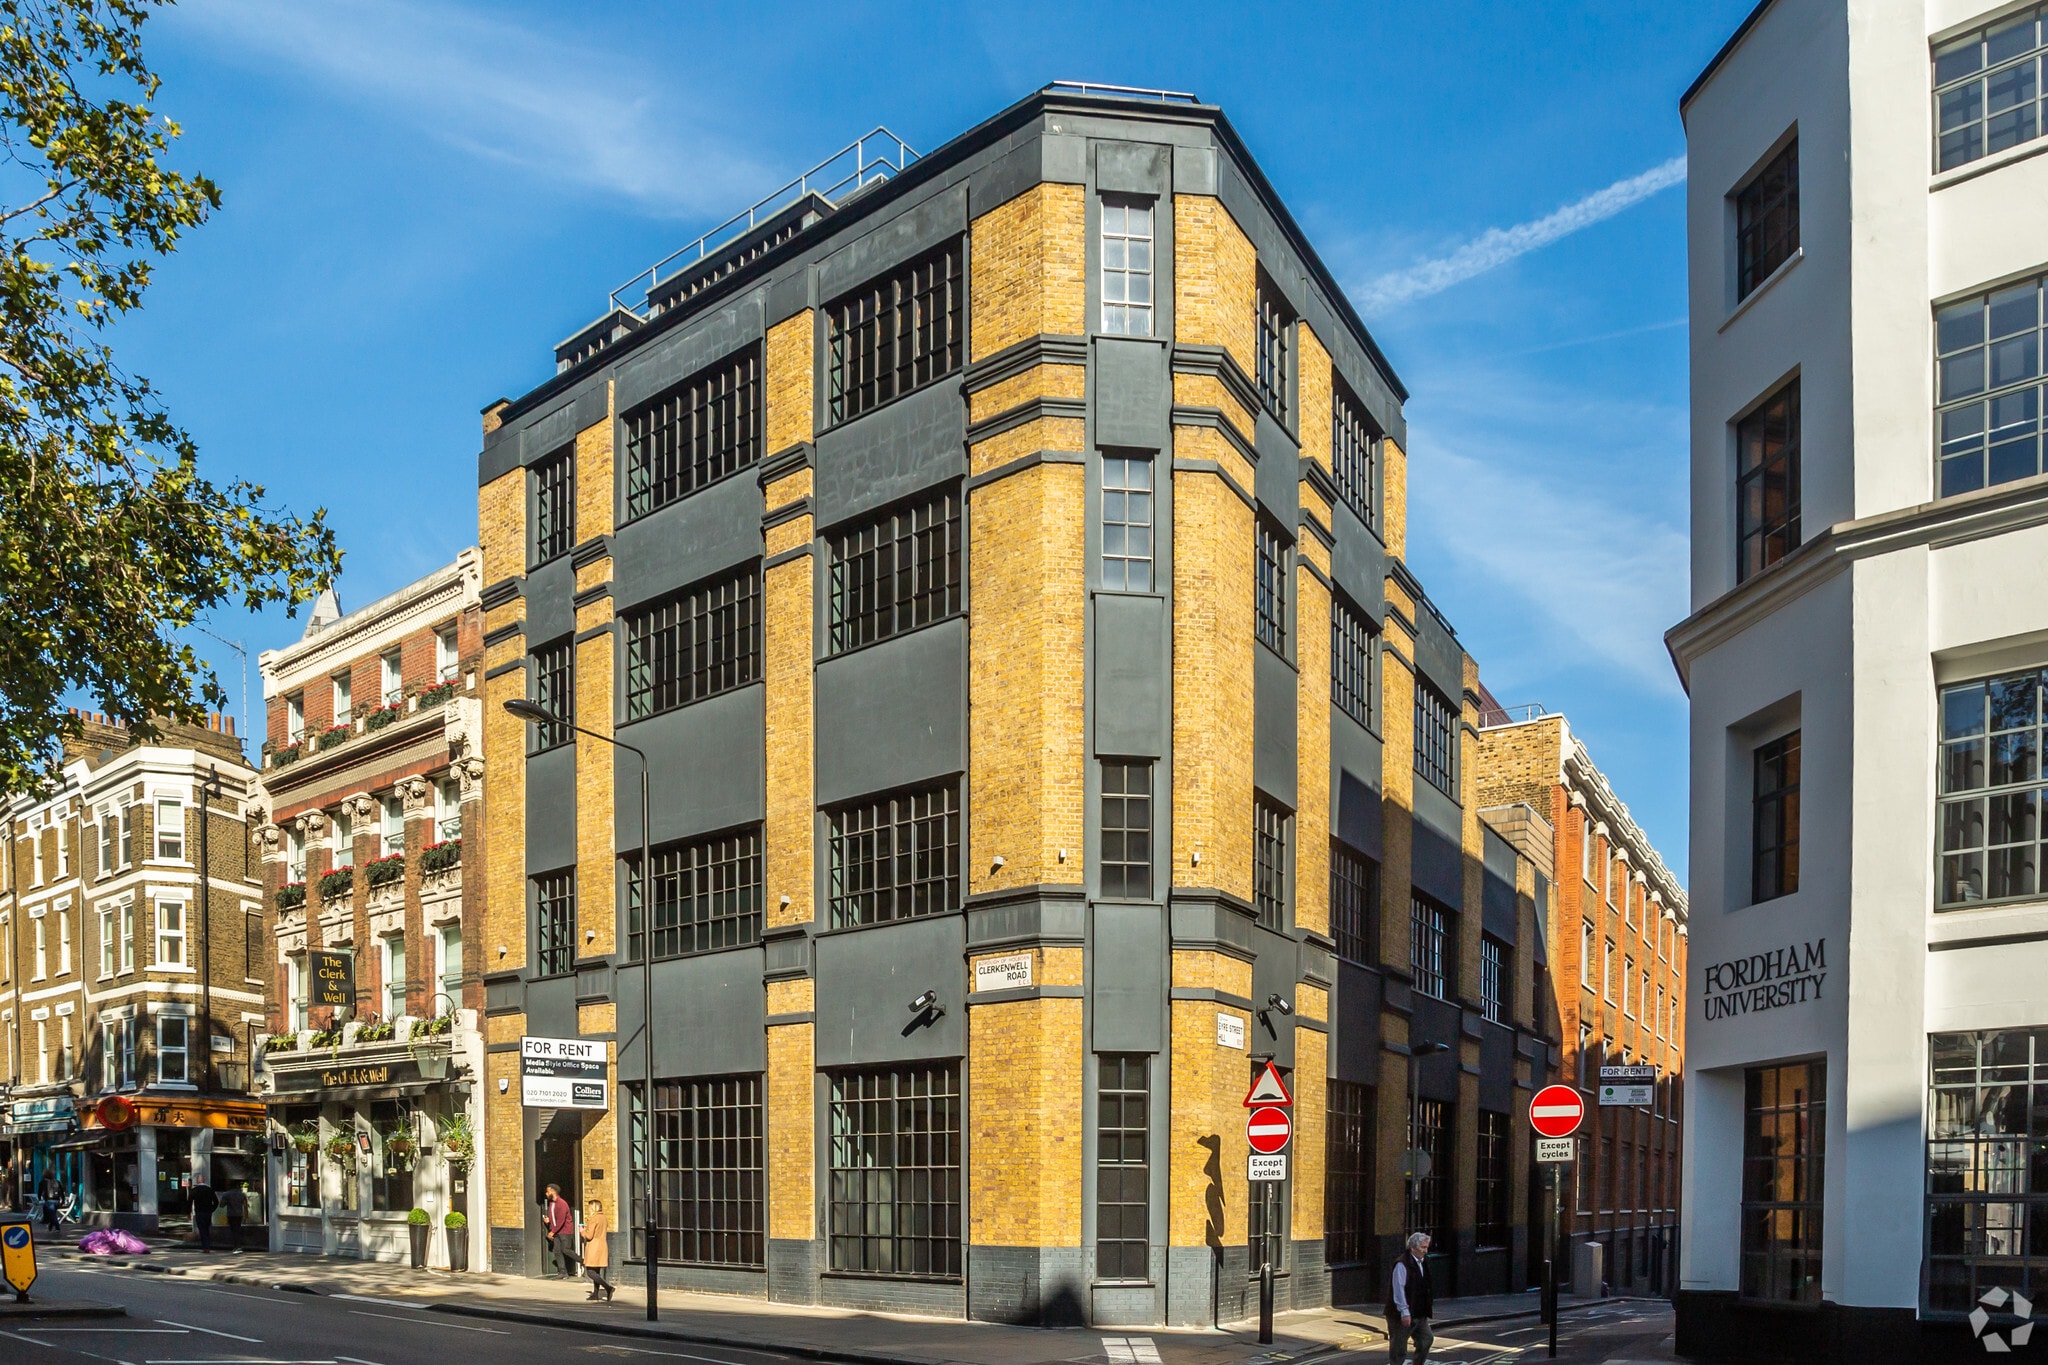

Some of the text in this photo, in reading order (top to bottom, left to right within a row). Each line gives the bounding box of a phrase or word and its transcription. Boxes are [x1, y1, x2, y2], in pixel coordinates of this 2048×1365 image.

[322, 956, 342, 967] The
[1704, 937, 1827, 995] FORDHAM
[978, 961, 1028, 975] CLERKENWELL
[319, 968, 345, 980] Clerk
[1006, 970, 1027, 981] ROAD
[328, 980, 338, 991] &
[323, 992, 346, 1004] Well
[1704, 972, 1827, 1021] UNIVERSITY
[525, 1041, 592, 1056] FOR RENT
[525, 1059, 600, 1070] Media Style Office Space
[321, 1071, 337, 1086] The
[360, 1068, 369, 1084] &
[369, 1066, 388, 1083] Well
[525, 1067, 555, 1075] Available
[1601, 1067, 1648, 1076] FOR RENT
[574, 1086, 602, 1095] Colliers
[1541, 1141, 1570, 1150] Except
[1542, 1151, 1569, 1159] cycles
[1252, 1158, 1283, 1167] Except
[1253, 1168, 1281, 1177] cycles
